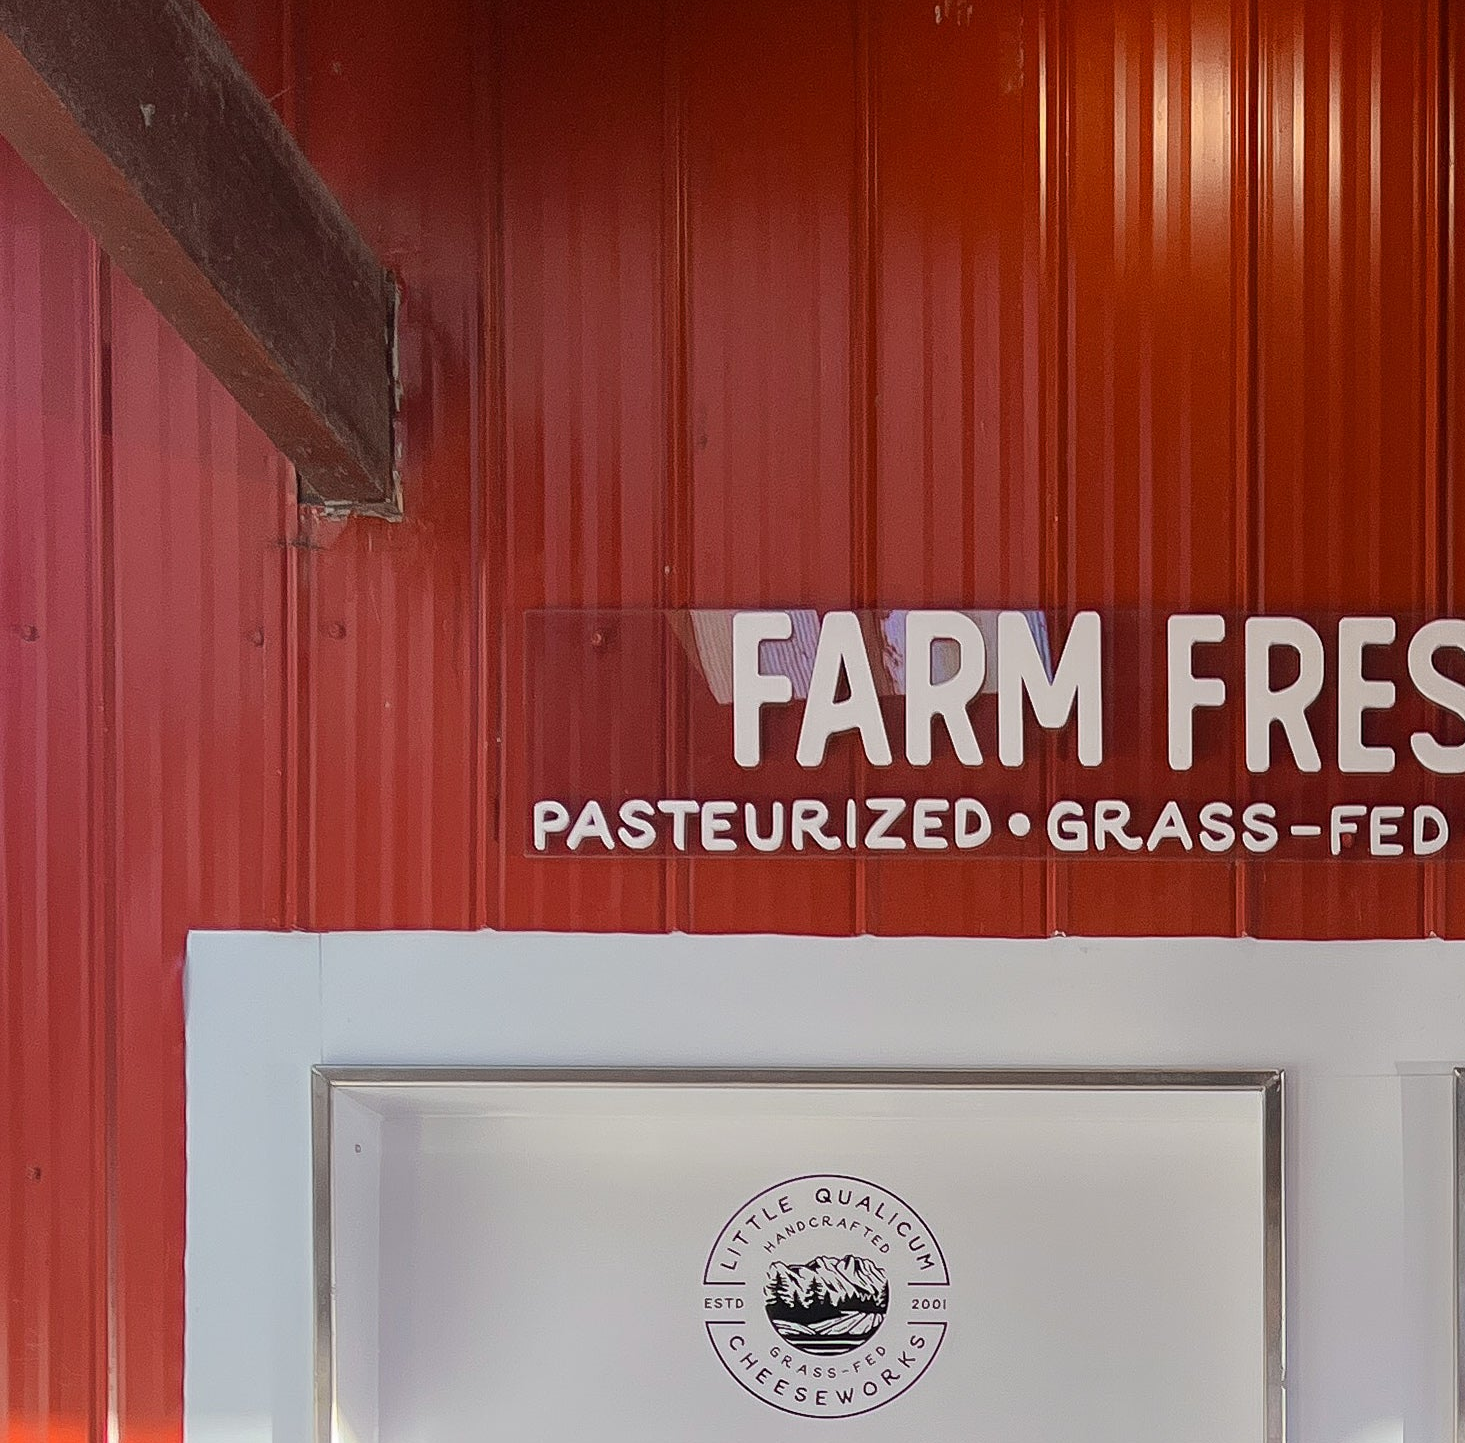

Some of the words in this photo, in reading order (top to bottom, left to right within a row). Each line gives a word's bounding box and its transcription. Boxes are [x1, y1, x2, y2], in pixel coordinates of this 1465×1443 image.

[731, 609, 1104, 769] FARM
[532, 798, 991, 853] PASTEURIZED
[1046, 801, 1449, 858] GRASS-FED
[720, 1195, 793, 1271] LITTLE
[815, 1187, 935, 1271] QUALICUM
[763, 1215, 890, 1254] HANDCRAFTED
[704, 1297, 744, 1309] ESTD
[911, 1298, 947, 1310] 2001
[728, 1334, 926, 1406] CHEESEWORKS
[769, 1346, 886, 1379] GRASS-FED
